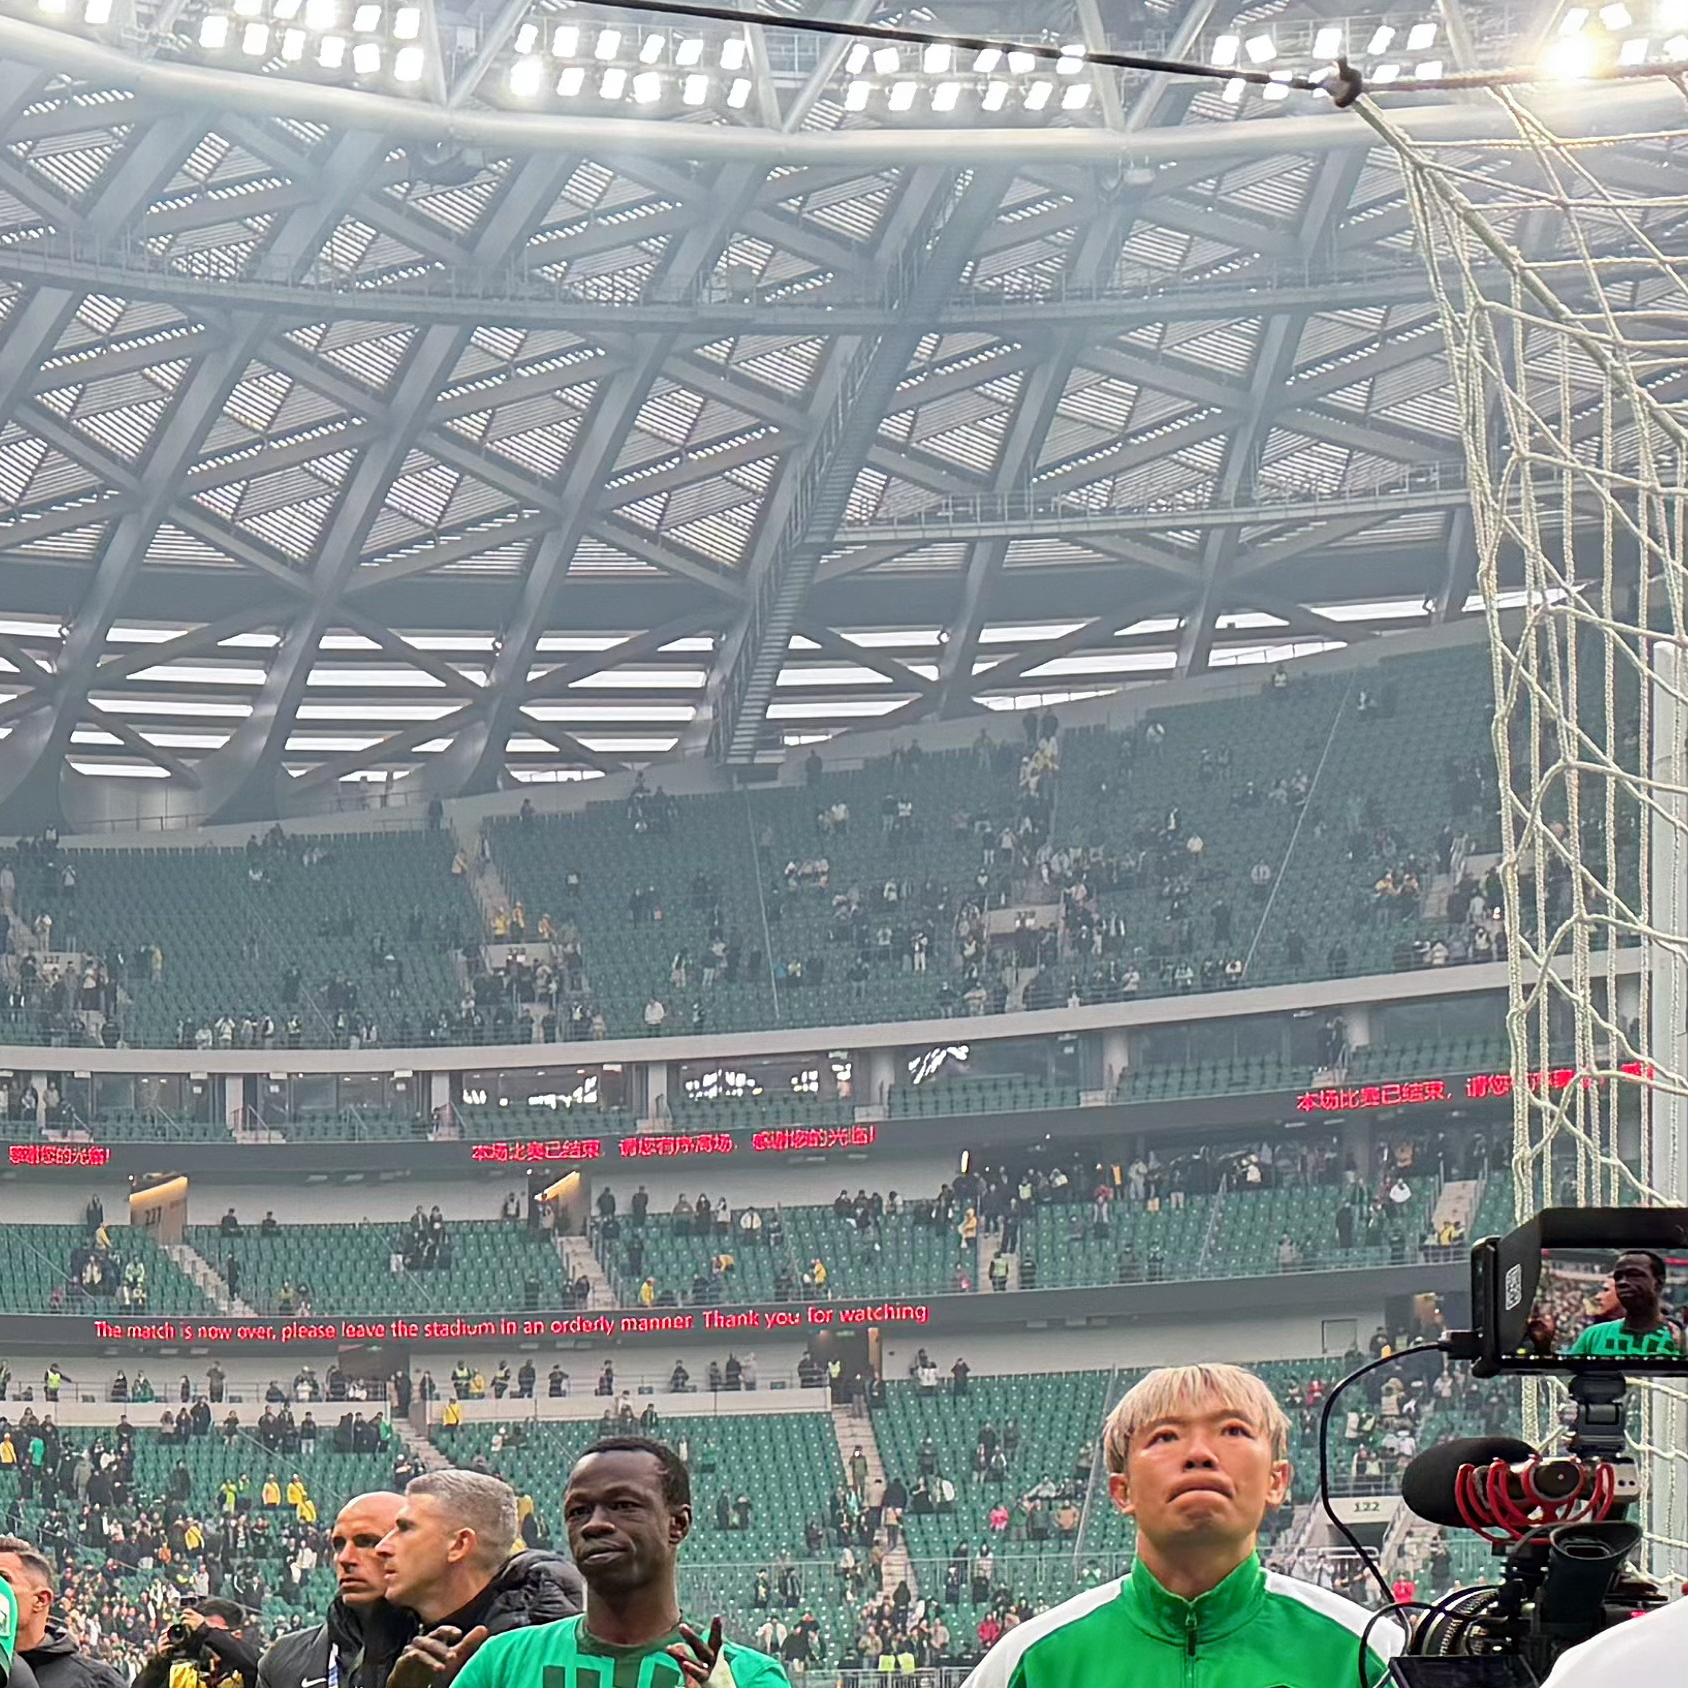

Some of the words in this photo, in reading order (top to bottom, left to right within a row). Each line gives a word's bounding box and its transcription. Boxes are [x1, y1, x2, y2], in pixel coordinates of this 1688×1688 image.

[95, 1320, 122, 1338] The
[126, 1324, 176, 1340] match
[179, 1321, 193, 1342] is
[197, 1326, 233, 1342] now
[281, 1324, 337, 1344] please
[341, 1321, 386, 1340] leave
[391, 1320, 420, 1340] the
[424, 1320, 496, 1340] stadium
[501, 1320, 519, 1336] in
[525, 1320, 545, 1336] an
[550, 1316, 615, 1336] orderly
[703, 1309, 761, 1330] Thank
[765, 1312, 802, 1329] you
[807, 1306, 833, 1324] for
[839, 1304, 930, 1324] watching
[1353, 1500, 1381, 1514] 122
